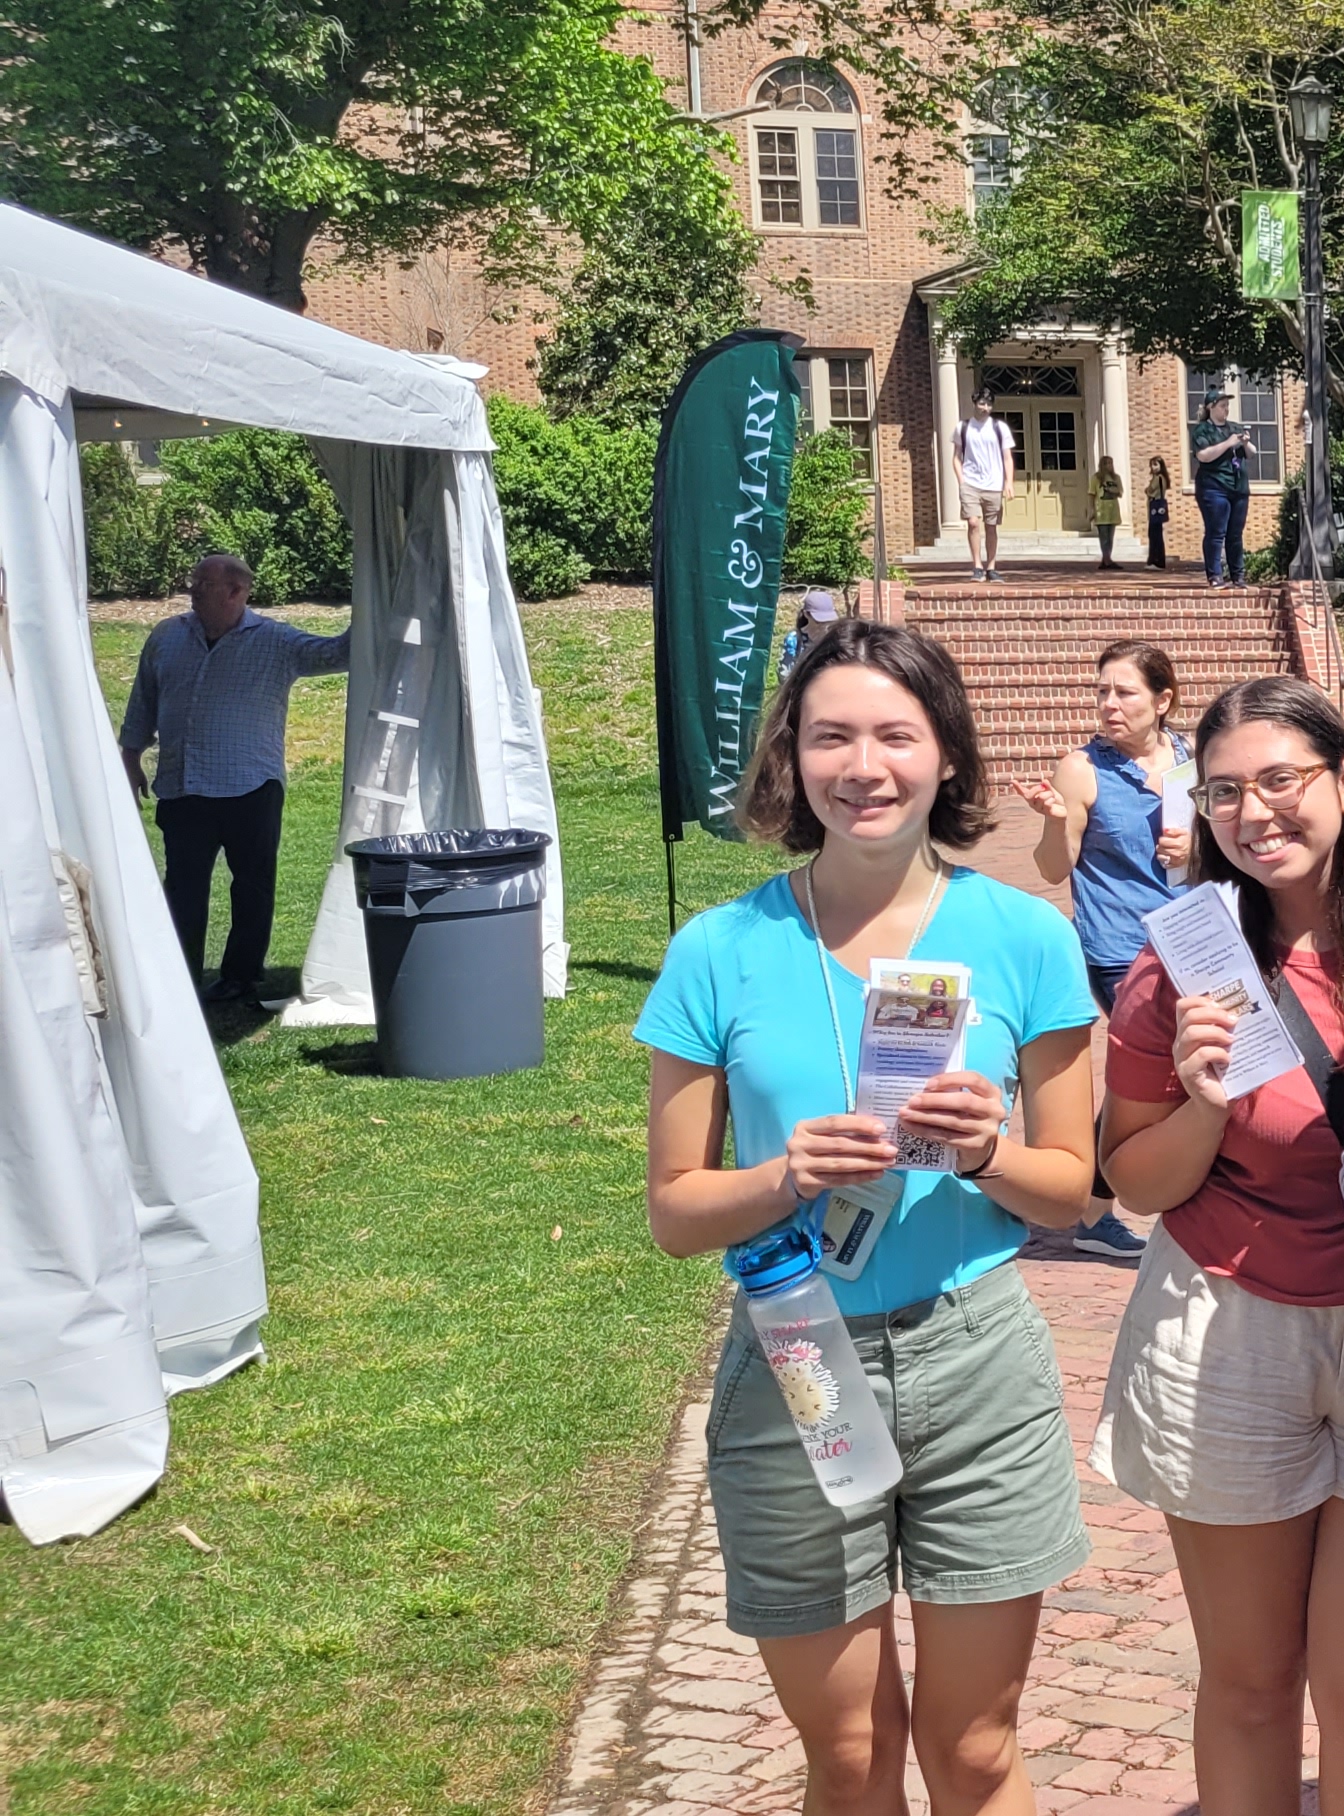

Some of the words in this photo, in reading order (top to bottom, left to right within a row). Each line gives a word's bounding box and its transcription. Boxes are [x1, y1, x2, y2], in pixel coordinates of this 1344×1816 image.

[1258, 204, 1271, 262] ADMITTED
[1270, 217, 1285, 277] STUDENTS
[734, 376, 779, 533] MARY
[728, 539, 763, 589] &
[708, 598, 758, 820] WILLIAM
[821, 1422, 853, 1440] YOUR
